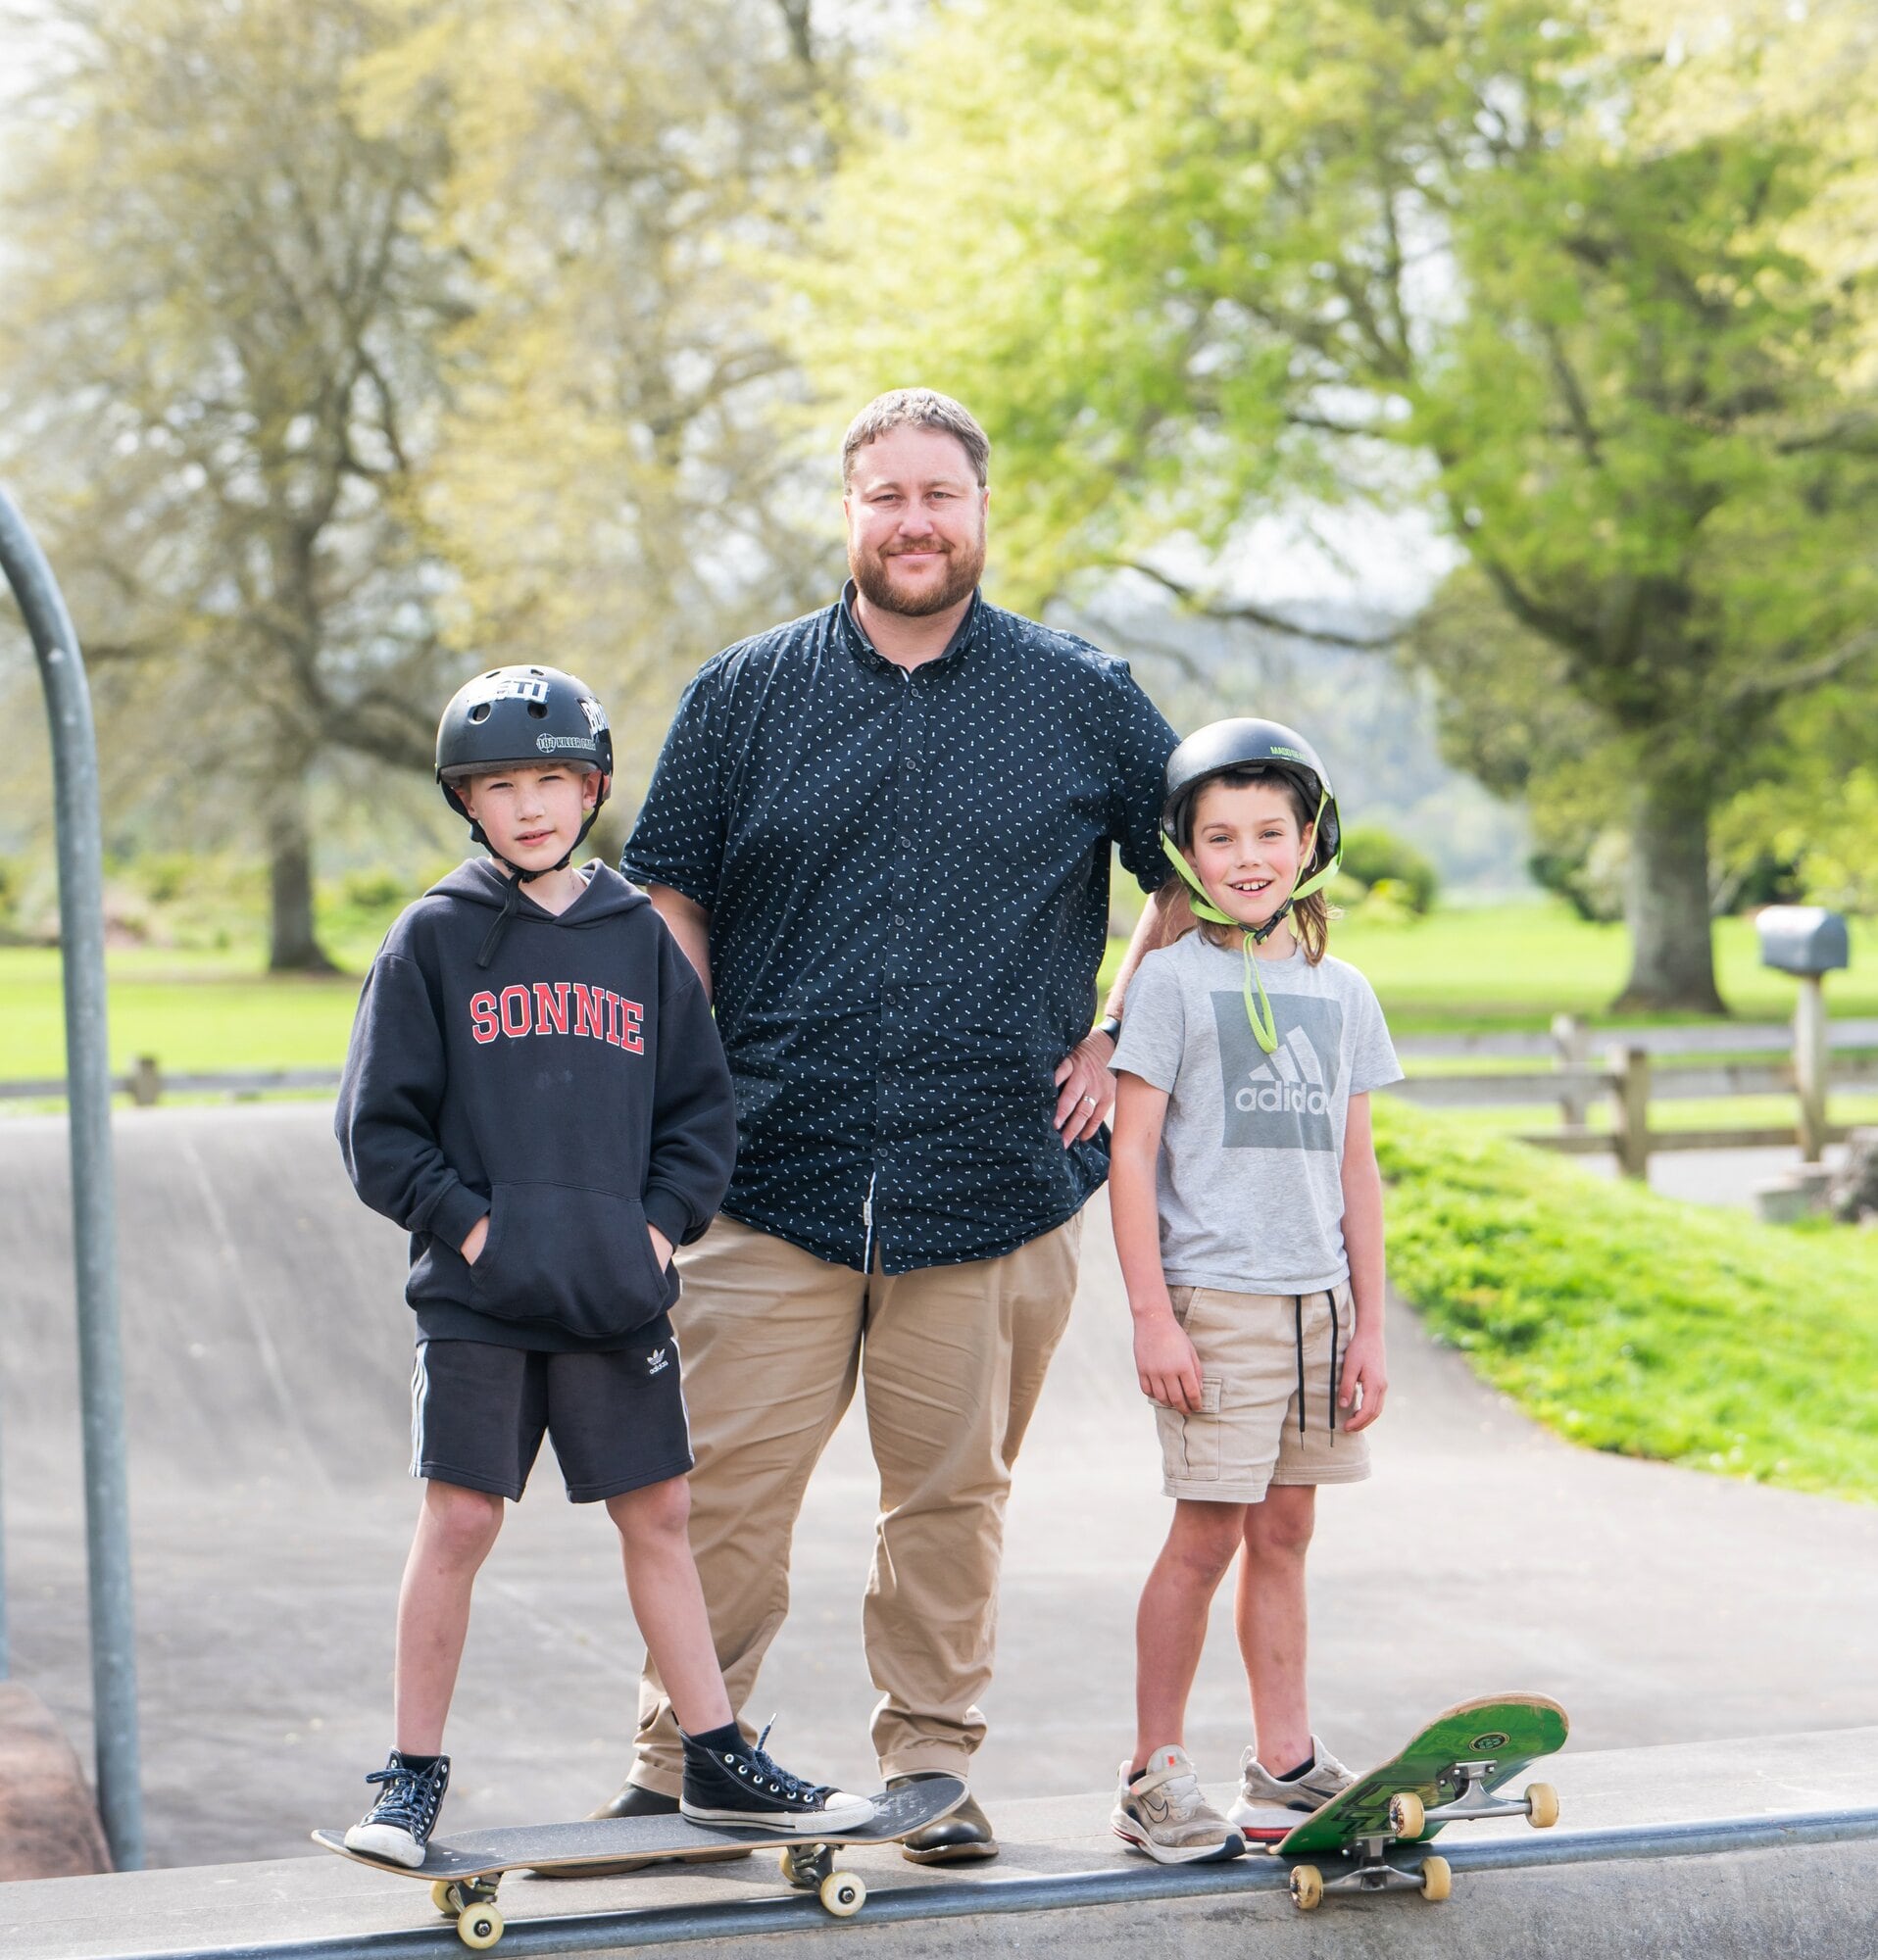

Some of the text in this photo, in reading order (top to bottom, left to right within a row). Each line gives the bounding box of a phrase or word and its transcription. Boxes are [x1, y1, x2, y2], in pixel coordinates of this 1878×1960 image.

[479, 677, 545, 701] ETI
[556, 737, 580, 749] KILLER
[470, 982, 644, 1055] SONNIE
[1235, 1079, 1328, 1115] adida
